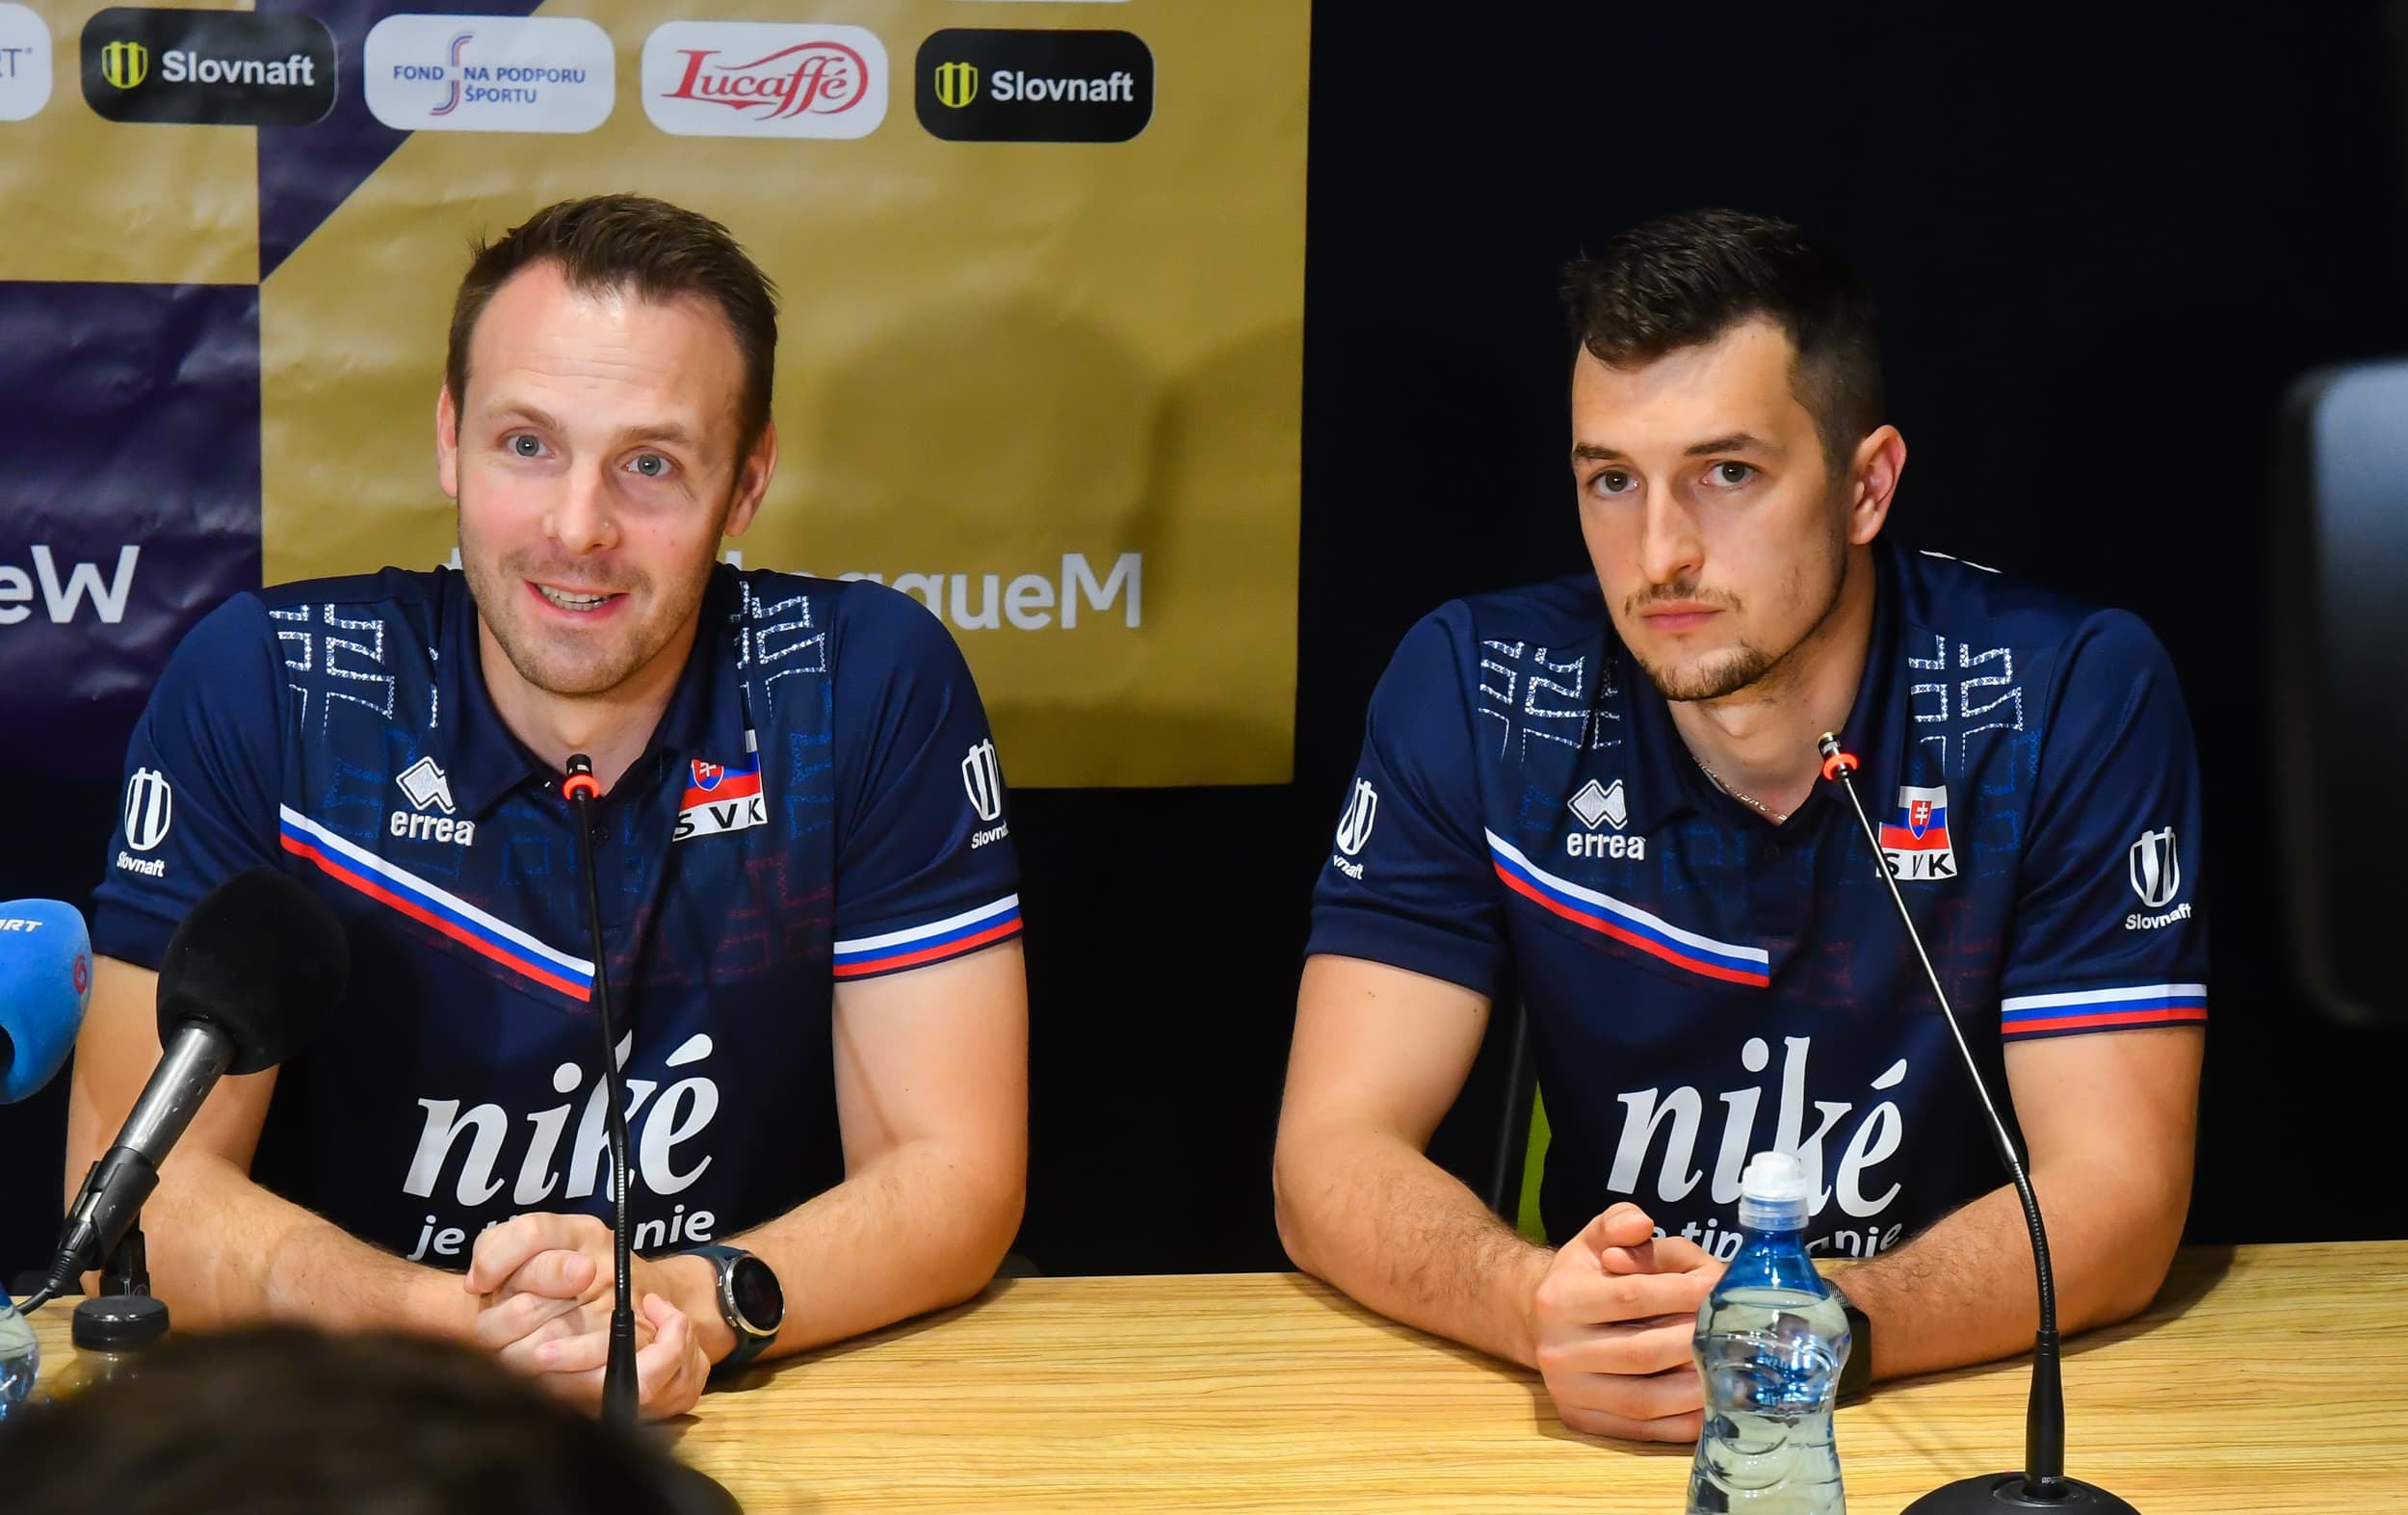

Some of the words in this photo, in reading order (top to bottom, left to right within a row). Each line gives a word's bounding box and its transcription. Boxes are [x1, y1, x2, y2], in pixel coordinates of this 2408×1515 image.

[162, 51, 315, 87] Slovnaft
[393, 65, 444, 81] FOND
[463, 67, 489, 82] NA
[496, 68, 586, 84] PODPORU
[662, 40, 868, 121] Lucaffé
[464, 84, 537, 104] ŠPORTU
[990, 71, 1134, 102] Slovnaft
[390, 810, 475, 847] errea
[1567, 832, 1644, 860] errea
[1333, 854, 1364, 880] vnaft
[2125, 902, 2191, 930] Slovnaft
[403, 1029, 719, 1207] niké
[1607, 1035, 1908, 1218] niké
[407, 1215, 466, 1262] je
